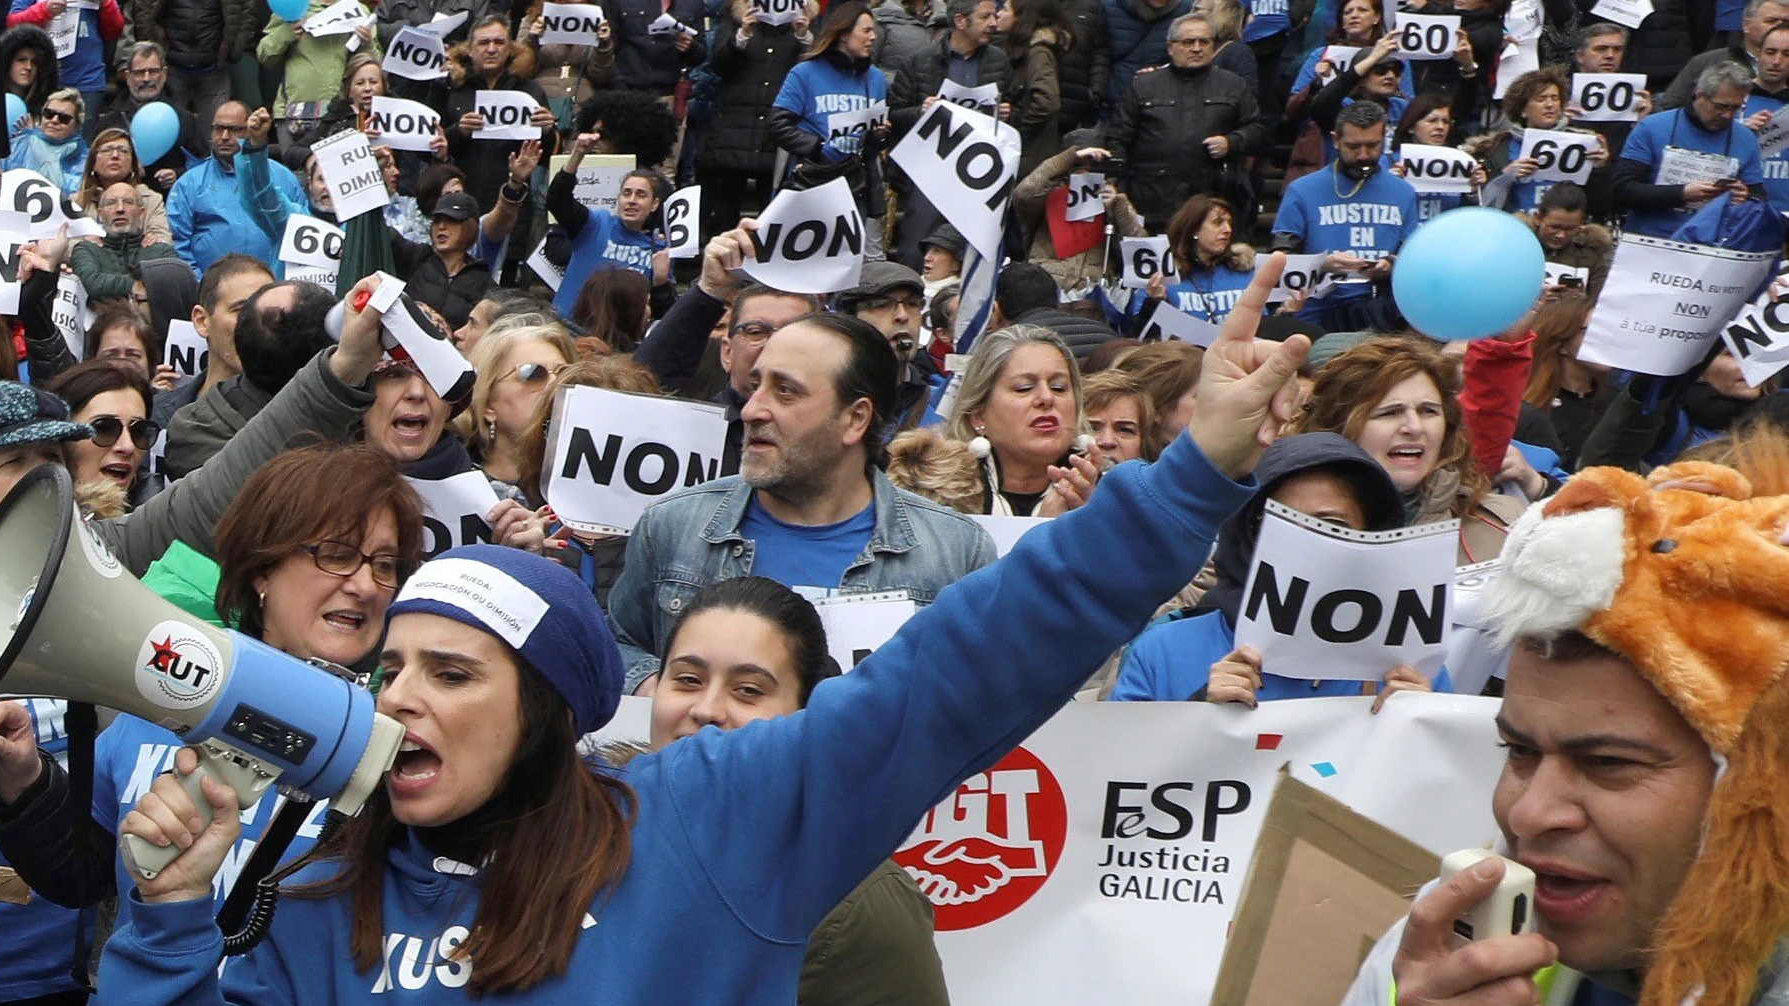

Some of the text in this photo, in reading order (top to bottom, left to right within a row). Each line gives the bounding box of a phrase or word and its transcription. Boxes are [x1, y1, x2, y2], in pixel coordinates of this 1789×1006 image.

[543, 16, 600, 34] NON
[1401, 22, 1450, 54] 60
[1580, 81, 1634, 112] 60
[372, 112, 436, 135] NON
[478, 105, 537, 126] NON
[1403, 158, 1474, 179] NON
[1530, 139, 1588, 174] 60
[1318, 203, 1403, 226] XUSTIZA
[293, 225, 343, 260] 60
[753, 210, 861, 263] NON
[1350, 226, 1374, 247] EN
[1676, 302, 1712, 317] NON
[1728, 293, 1789, 359] NO
[562, 427, 718, 495] NON
[415, 580, 472, 598] NEGOCIACIÓN
[486, 600, 522, 633] DIMISIÓN
[1245, 560, 1447, 646] NON
[152, 650, 210, 688] CUT
[1099, 843, 1230, 873] Justicia
[1100, 873, 1223, 905] GALICIA
